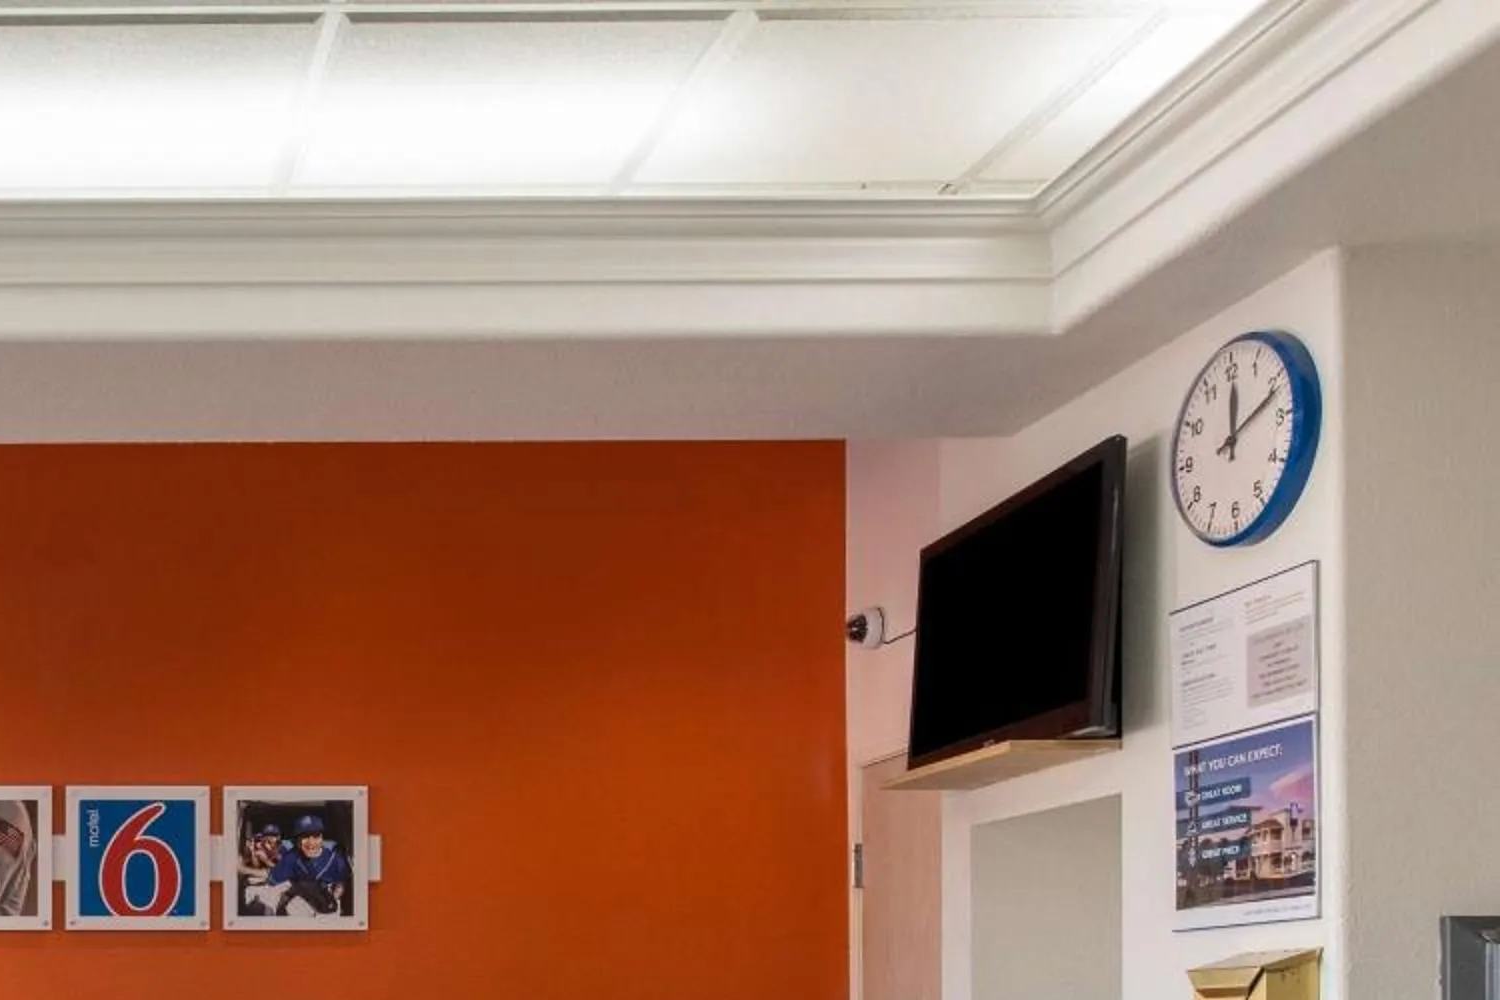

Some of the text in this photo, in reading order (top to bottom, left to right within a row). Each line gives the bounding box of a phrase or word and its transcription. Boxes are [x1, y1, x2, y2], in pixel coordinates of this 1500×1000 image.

[1225, 362, 1239, 383] 12
[1252, 361, 1259, 378] 1
[1204, 386, 1217, 404] 11
[1275, 407, 1286, 426] 3
[1190, 418, 1204, 437] 10
[1184, 456, 1194, 473] 9
[1267, 447, 1278, 464] 4
[1192, 485, 1202, 503] 8
[1253, 479, 1263, 498] 5
[1207, 502, 1217, 520] 7
[1231, 501, 1241, 518] 6
[1208, 757, 1226, 772] YOU
[1227, 752, 1247, 768] CAN
[86, 802, 182, 916] motel 6
